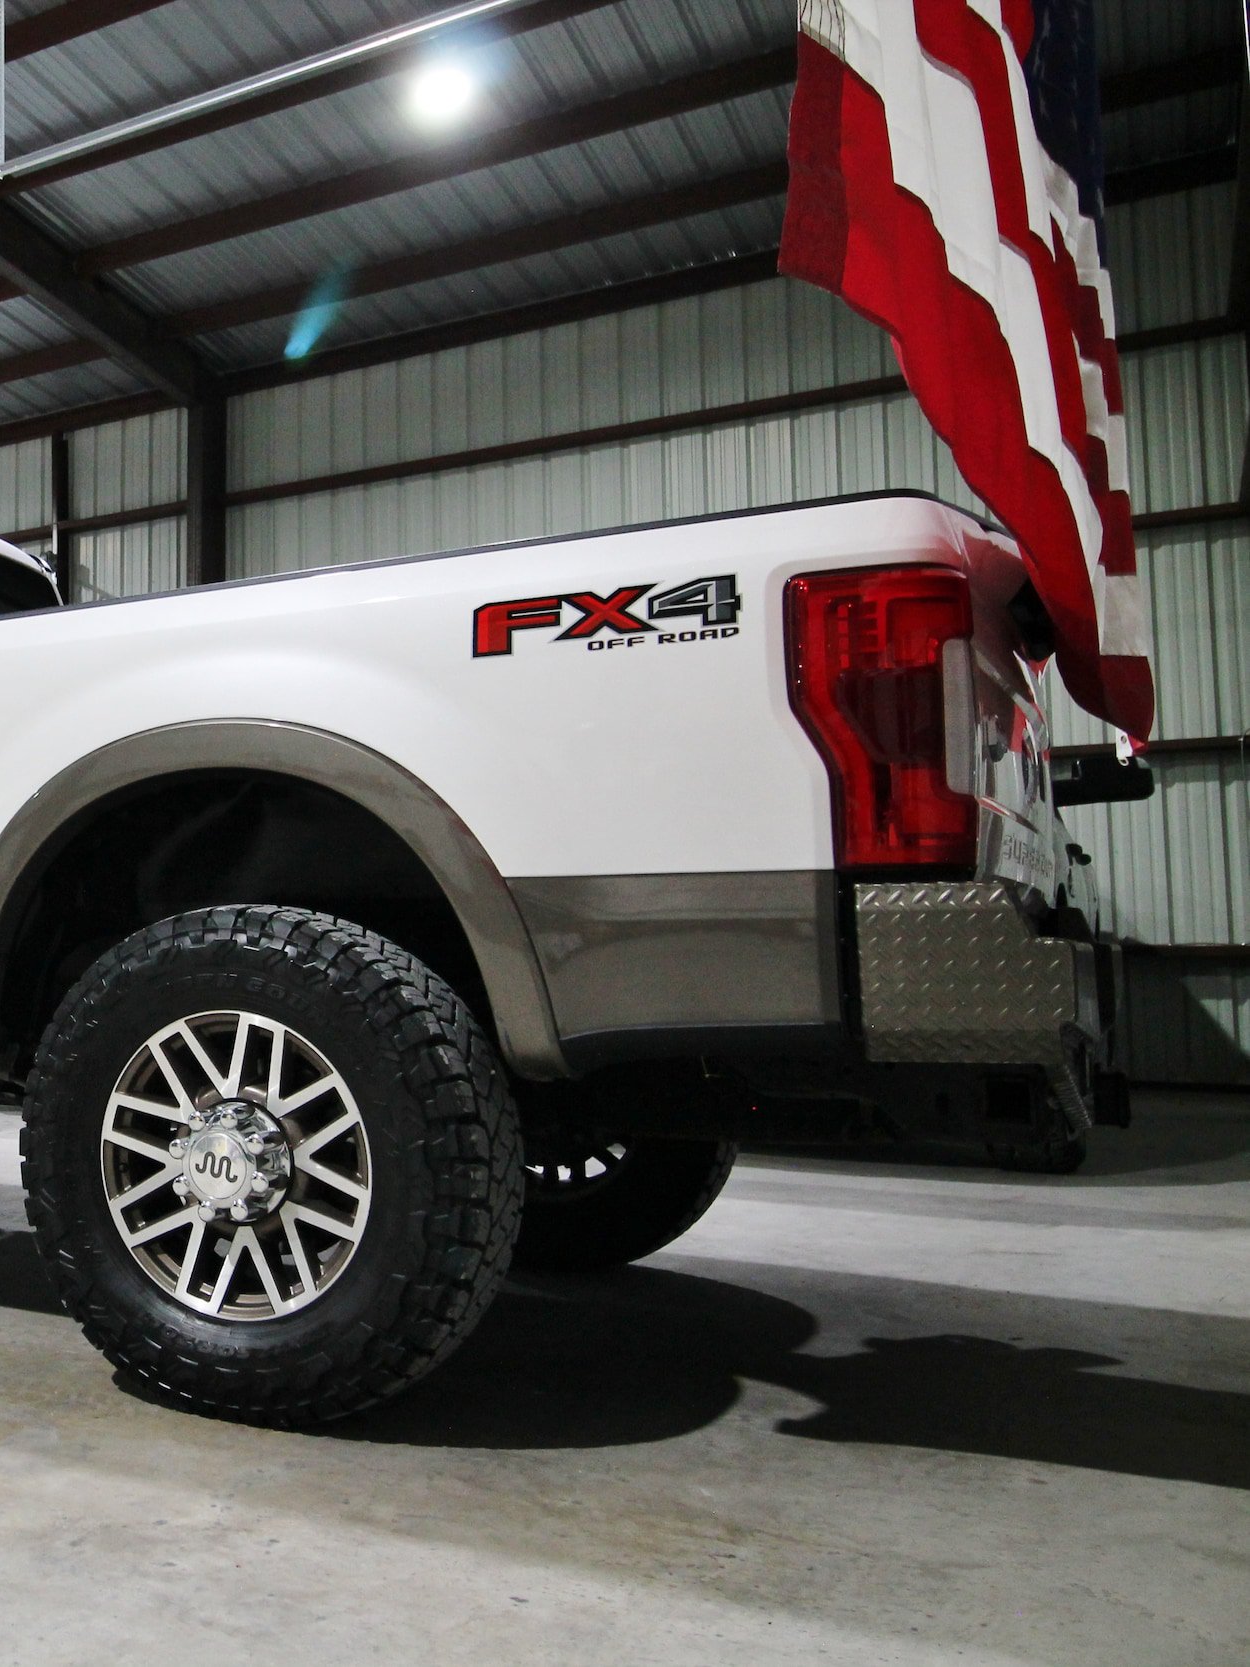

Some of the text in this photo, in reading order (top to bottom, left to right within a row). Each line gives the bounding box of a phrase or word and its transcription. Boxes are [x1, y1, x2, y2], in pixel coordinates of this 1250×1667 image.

[472, 573, 742, 659] FX4
[587, 626, 740, 652] OFF ROAD
